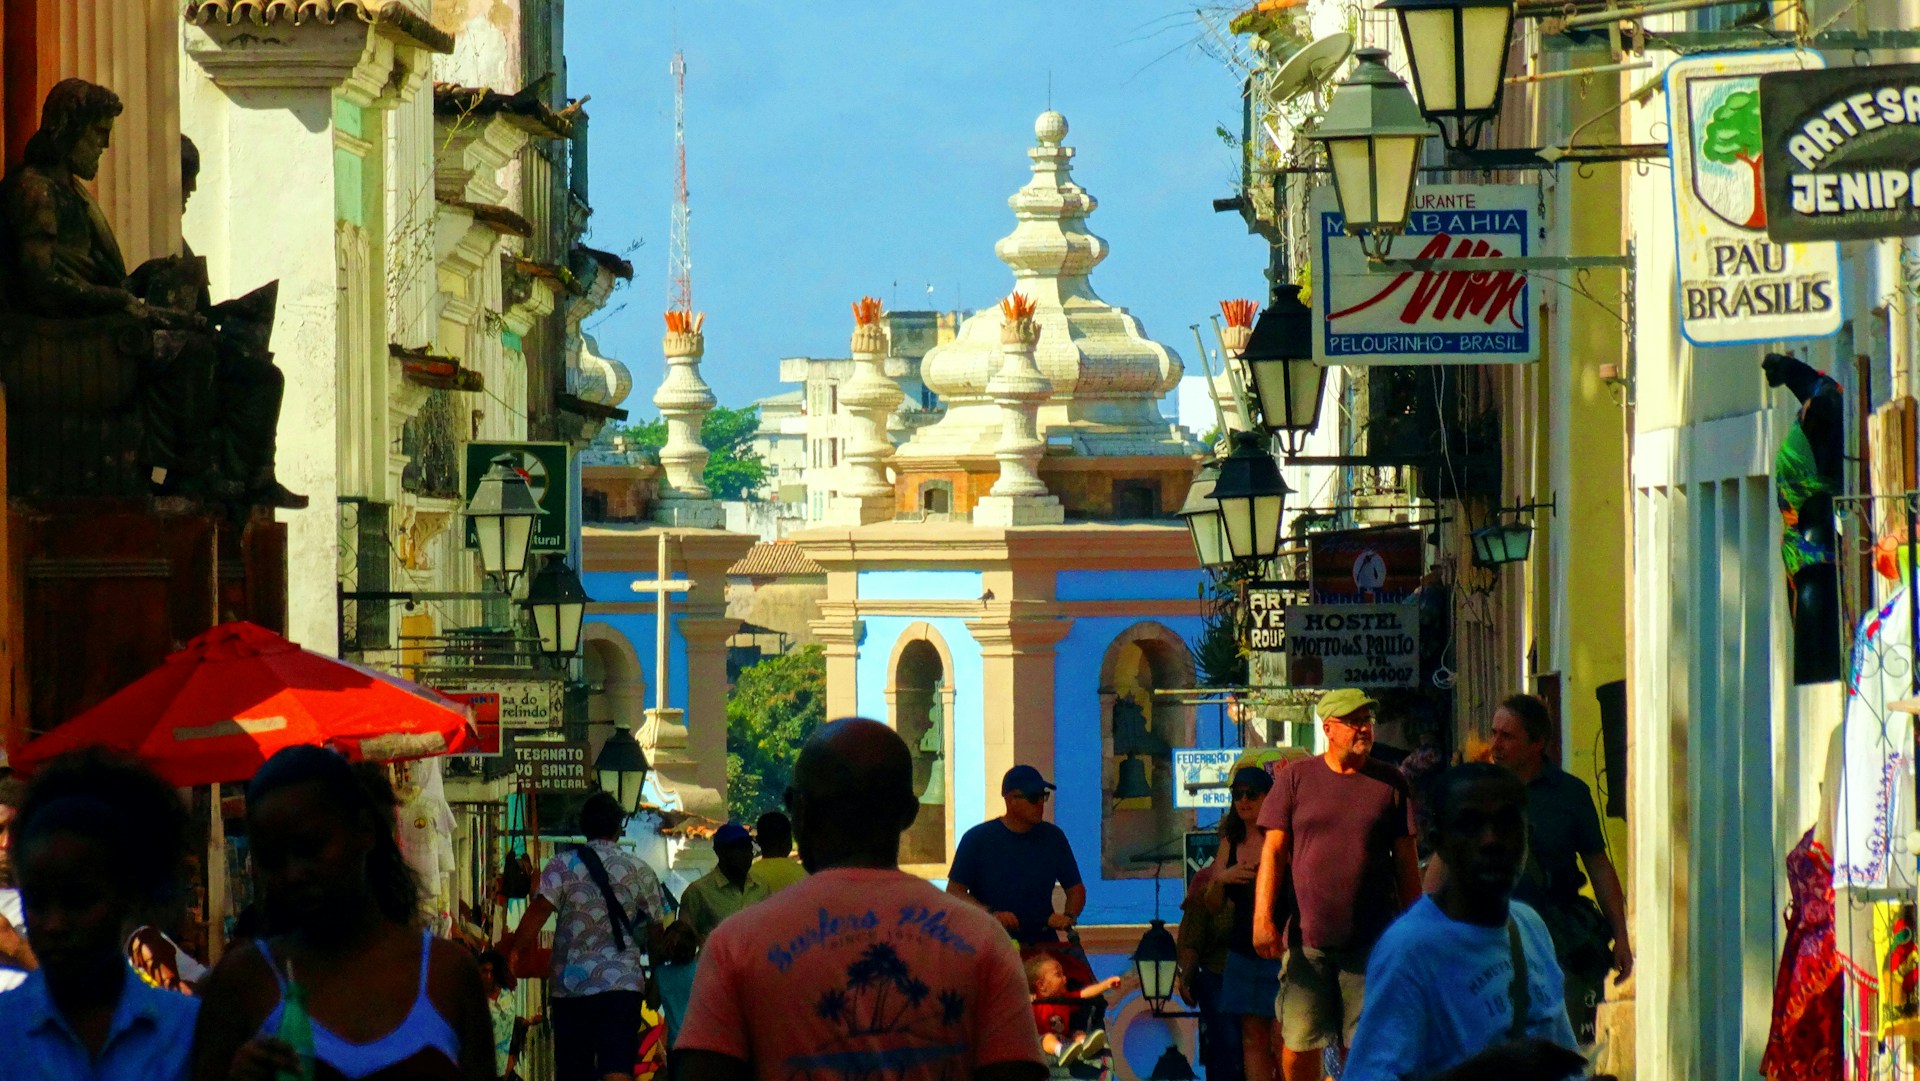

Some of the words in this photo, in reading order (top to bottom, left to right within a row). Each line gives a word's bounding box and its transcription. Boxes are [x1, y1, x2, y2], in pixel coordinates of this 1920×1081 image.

[1411, 194, 1476, 209] URANTE
[1713, 243, 1787, 277] PAU
[1686, 279, 1833, 321] BRASILIS
[1460, 334, 1522, 350] BRASIL
[1304, 612, 1402, 632] HOSTEL
